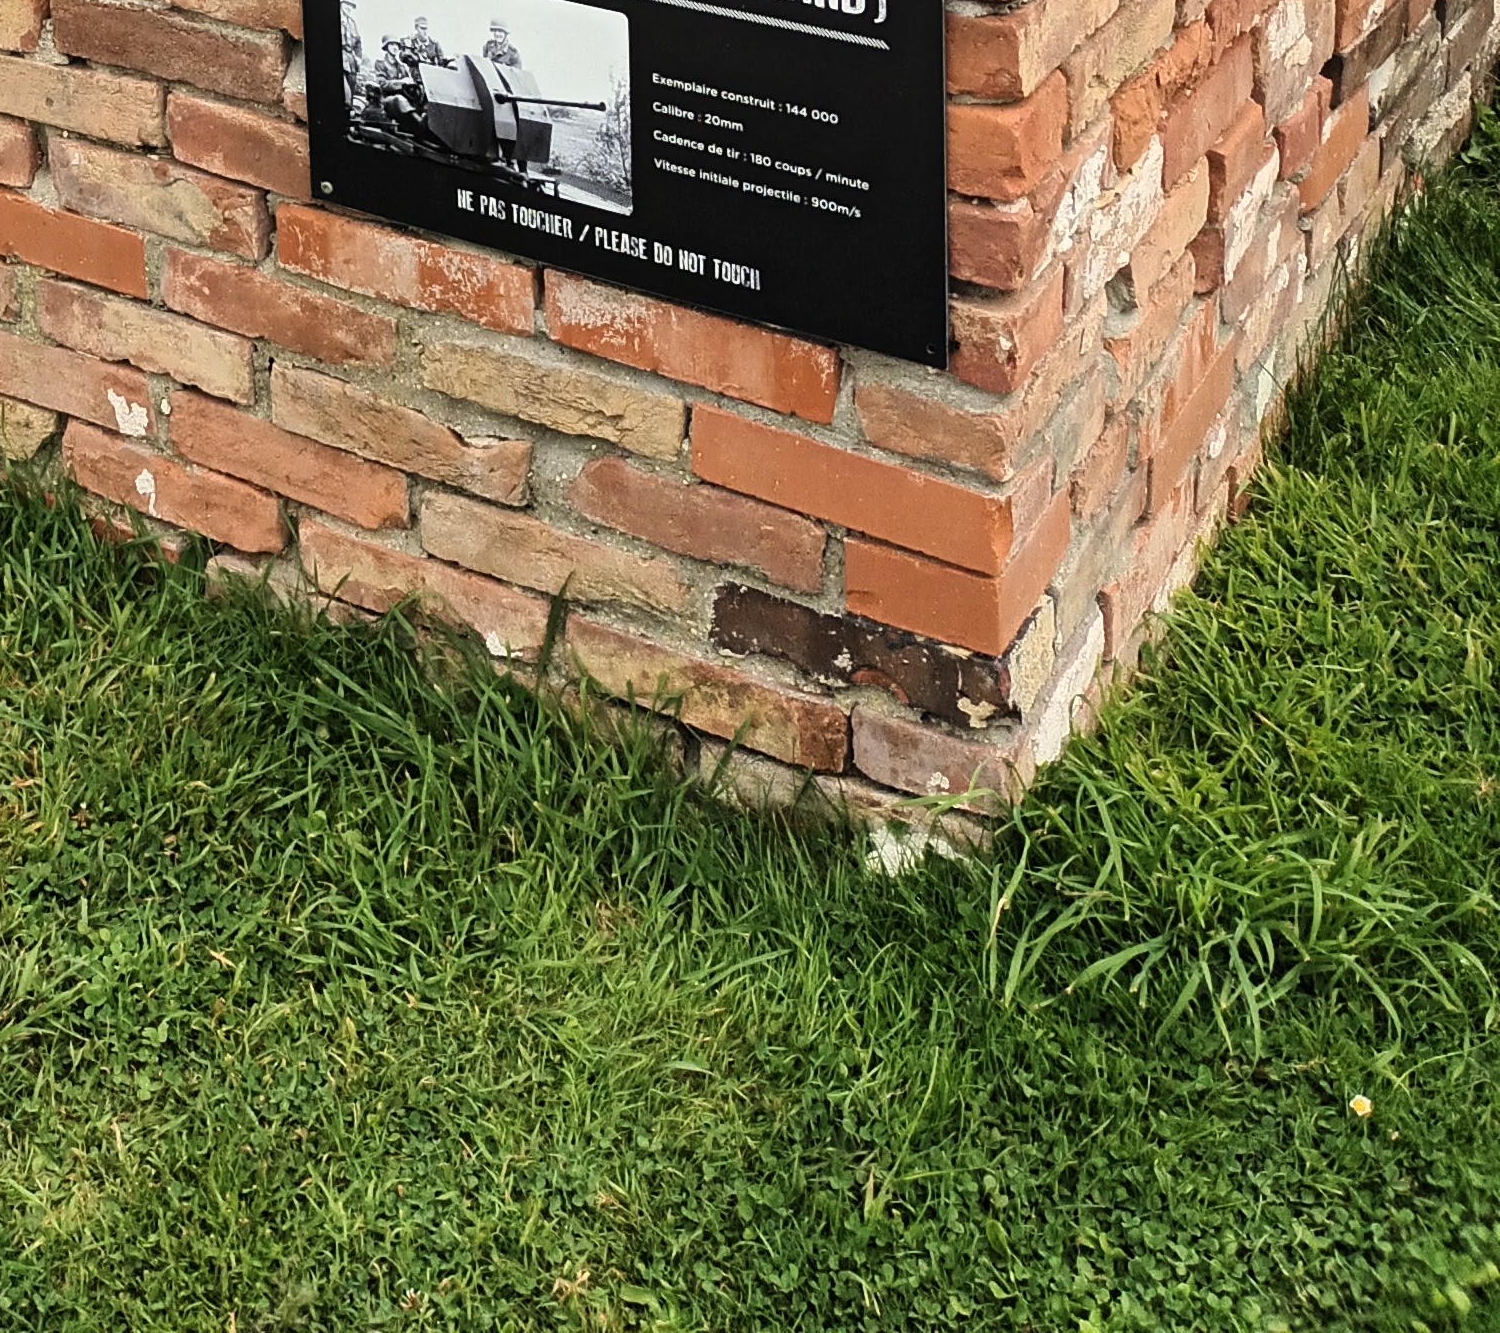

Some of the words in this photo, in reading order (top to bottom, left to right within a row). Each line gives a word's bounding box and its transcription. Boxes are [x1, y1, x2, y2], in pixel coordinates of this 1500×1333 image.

[652, 72, 718, 98] Exemplaire
[721, 90, 776, 111] construit
[785, 103, 808, 118] 144
[811, 109, 839, 124] 000
[652, 101, 695, 120] Calibre
[704, 113, 744, 132] 20mm
[653, 130, 705, 151] Cadence
[707, 143, 723, 156] de
[726, 147, 741, 160] tir
[749, 152, 772, 167] 180
[774, 160, 812, 178] coups
[825, 171, 870, 191] minute
[654, 157, 696, 177] Vitesse
[699, 169, 740, 188] initiale
[742, 181, 801, 204] projectile
[811, 196, 862, 218] 900m/s
[457, 188, 474, 212] NE
[480, 194, 506, 220] PAS
[511, 203, 573, 240] TOUCHER
[594, 226, 648, 260] PLEASE
[654, 242, 673, 266] DO
[679, 249, 706, 276] NOT
[713, 258, 761, 291] TOUCH
